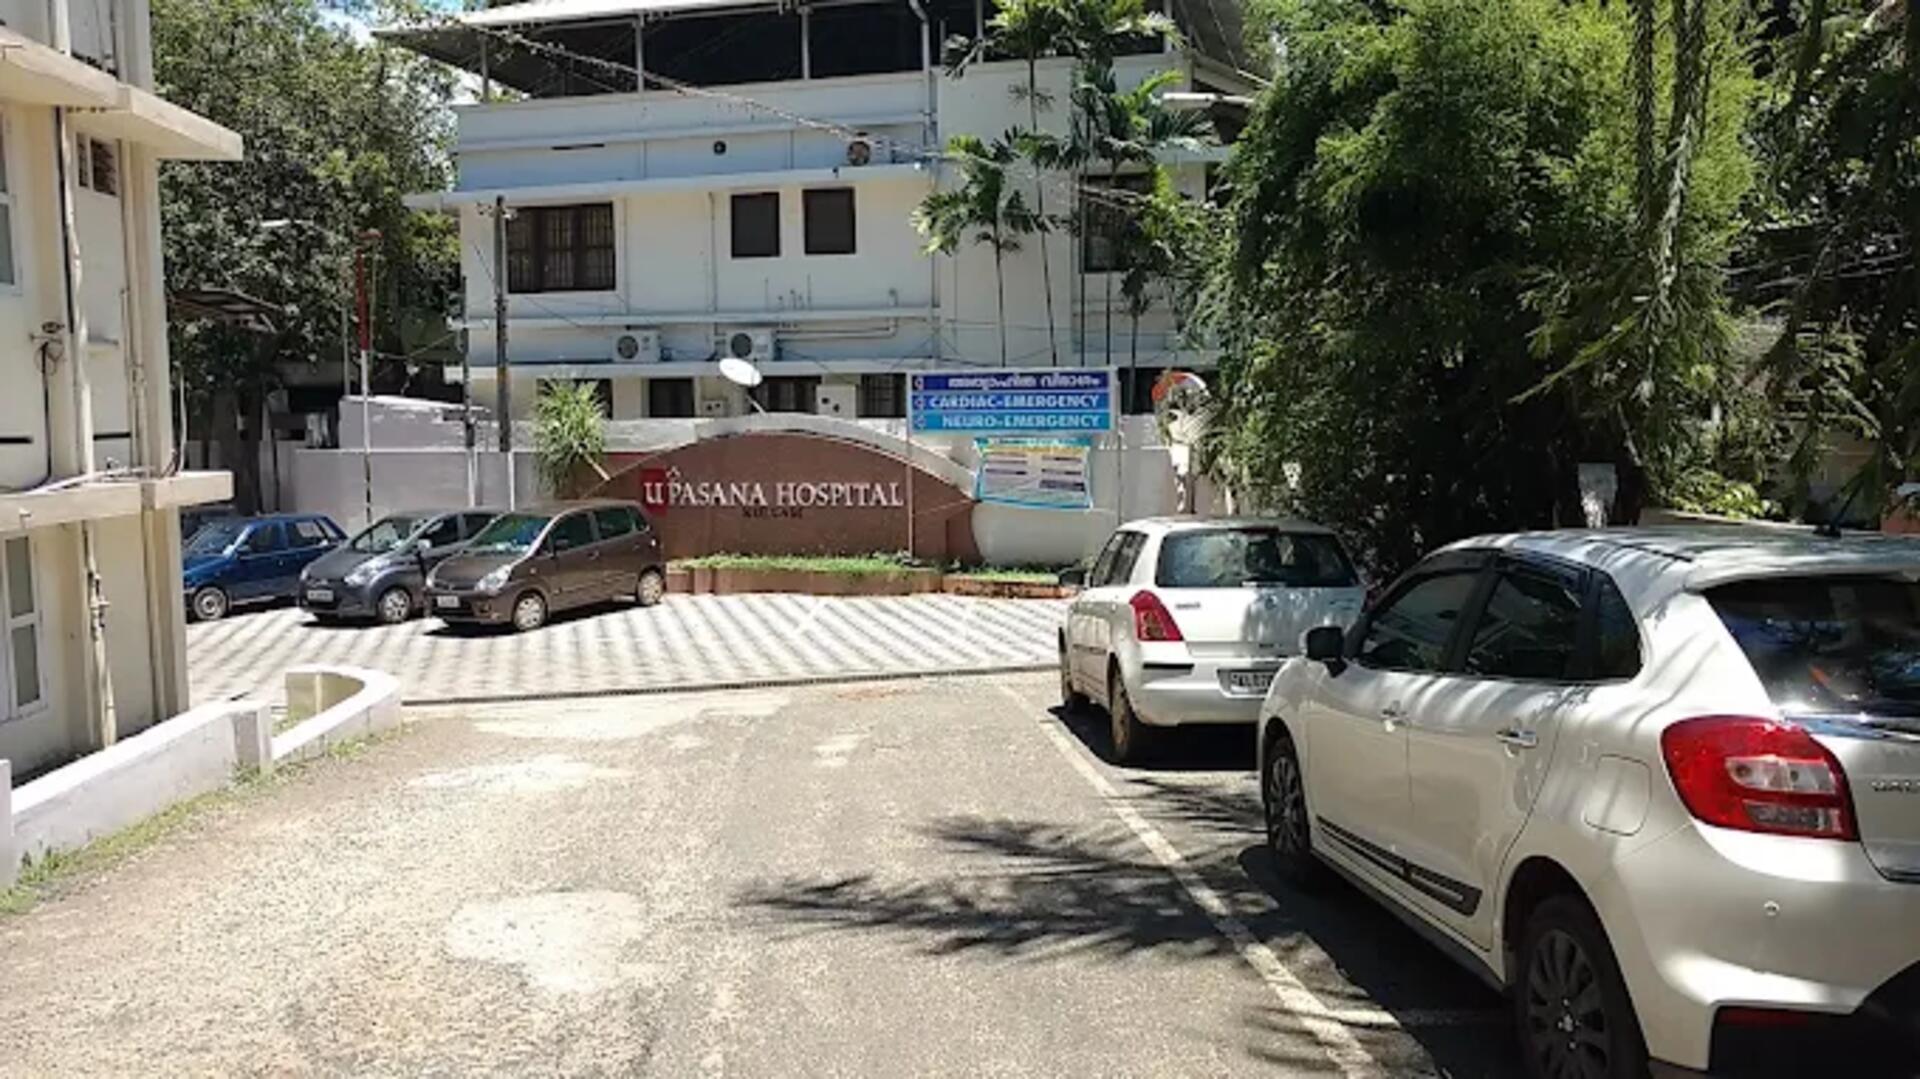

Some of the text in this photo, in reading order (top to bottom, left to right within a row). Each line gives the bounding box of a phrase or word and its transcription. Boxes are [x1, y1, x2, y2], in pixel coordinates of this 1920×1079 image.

[930, 395, 1099, 408] CARDIAC-EMERGENCY
[942, 415, 1099, 428] NEURO-EMERGENCY
[776, 482, 904, 506] HOSPITAL
